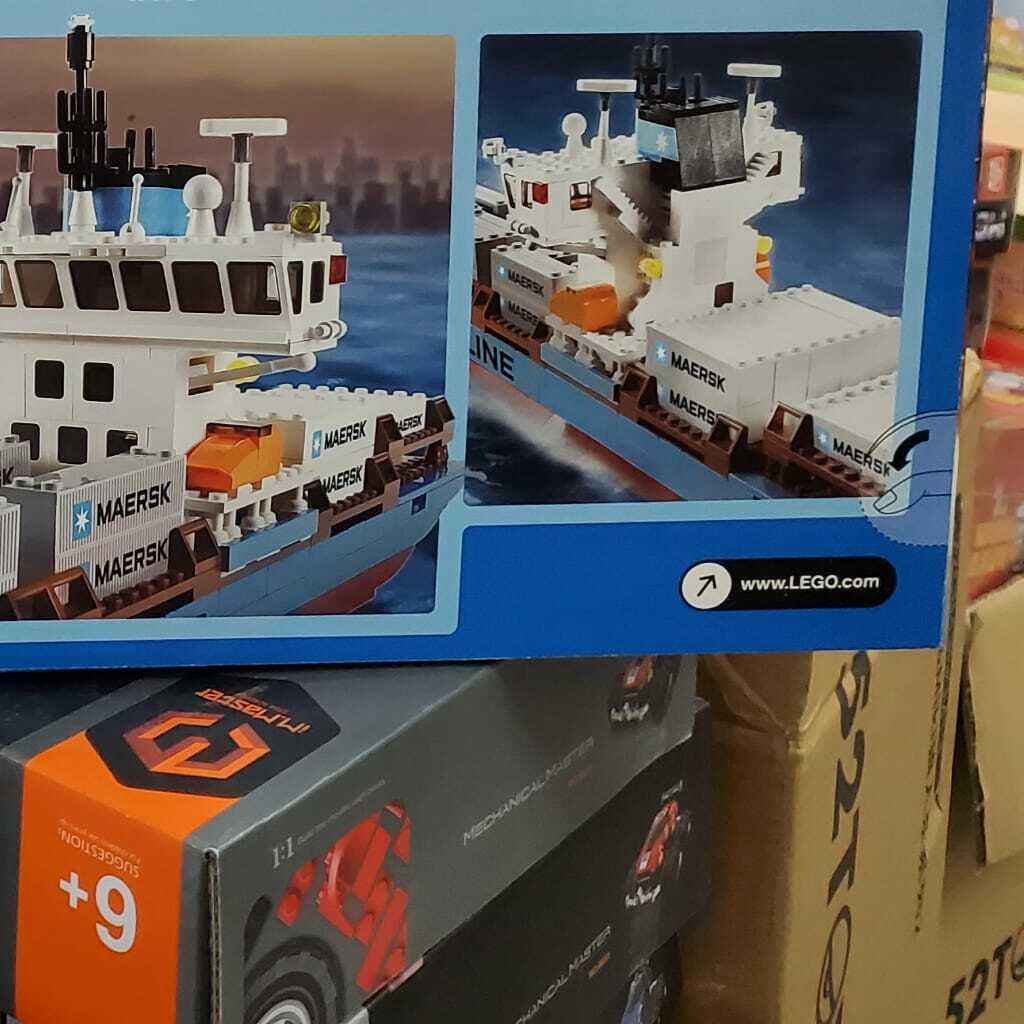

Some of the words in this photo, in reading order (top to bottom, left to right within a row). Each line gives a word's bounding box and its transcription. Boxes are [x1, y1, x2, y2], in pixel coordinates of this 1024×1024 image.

[508, 269, 545, 297] MAERSK
[469, 334, 515, 382] INE
[671, 351, 726, 393] MAERSK
[397, 414, 424, 432] AERSK
[669, 389, 717, 426] MAERS
[324, 419, 368, 450] MAERSK
[833, 438, 891, 477] MAERSK
[97, 480, 172, 526] MAERSK
[94, 537, 169, 587] MAERSK
[740, 575, 880, 592] www.LEGO.com
[272, 835, 296, 870] 1:1
[59, 871, 138, 953] 6+
